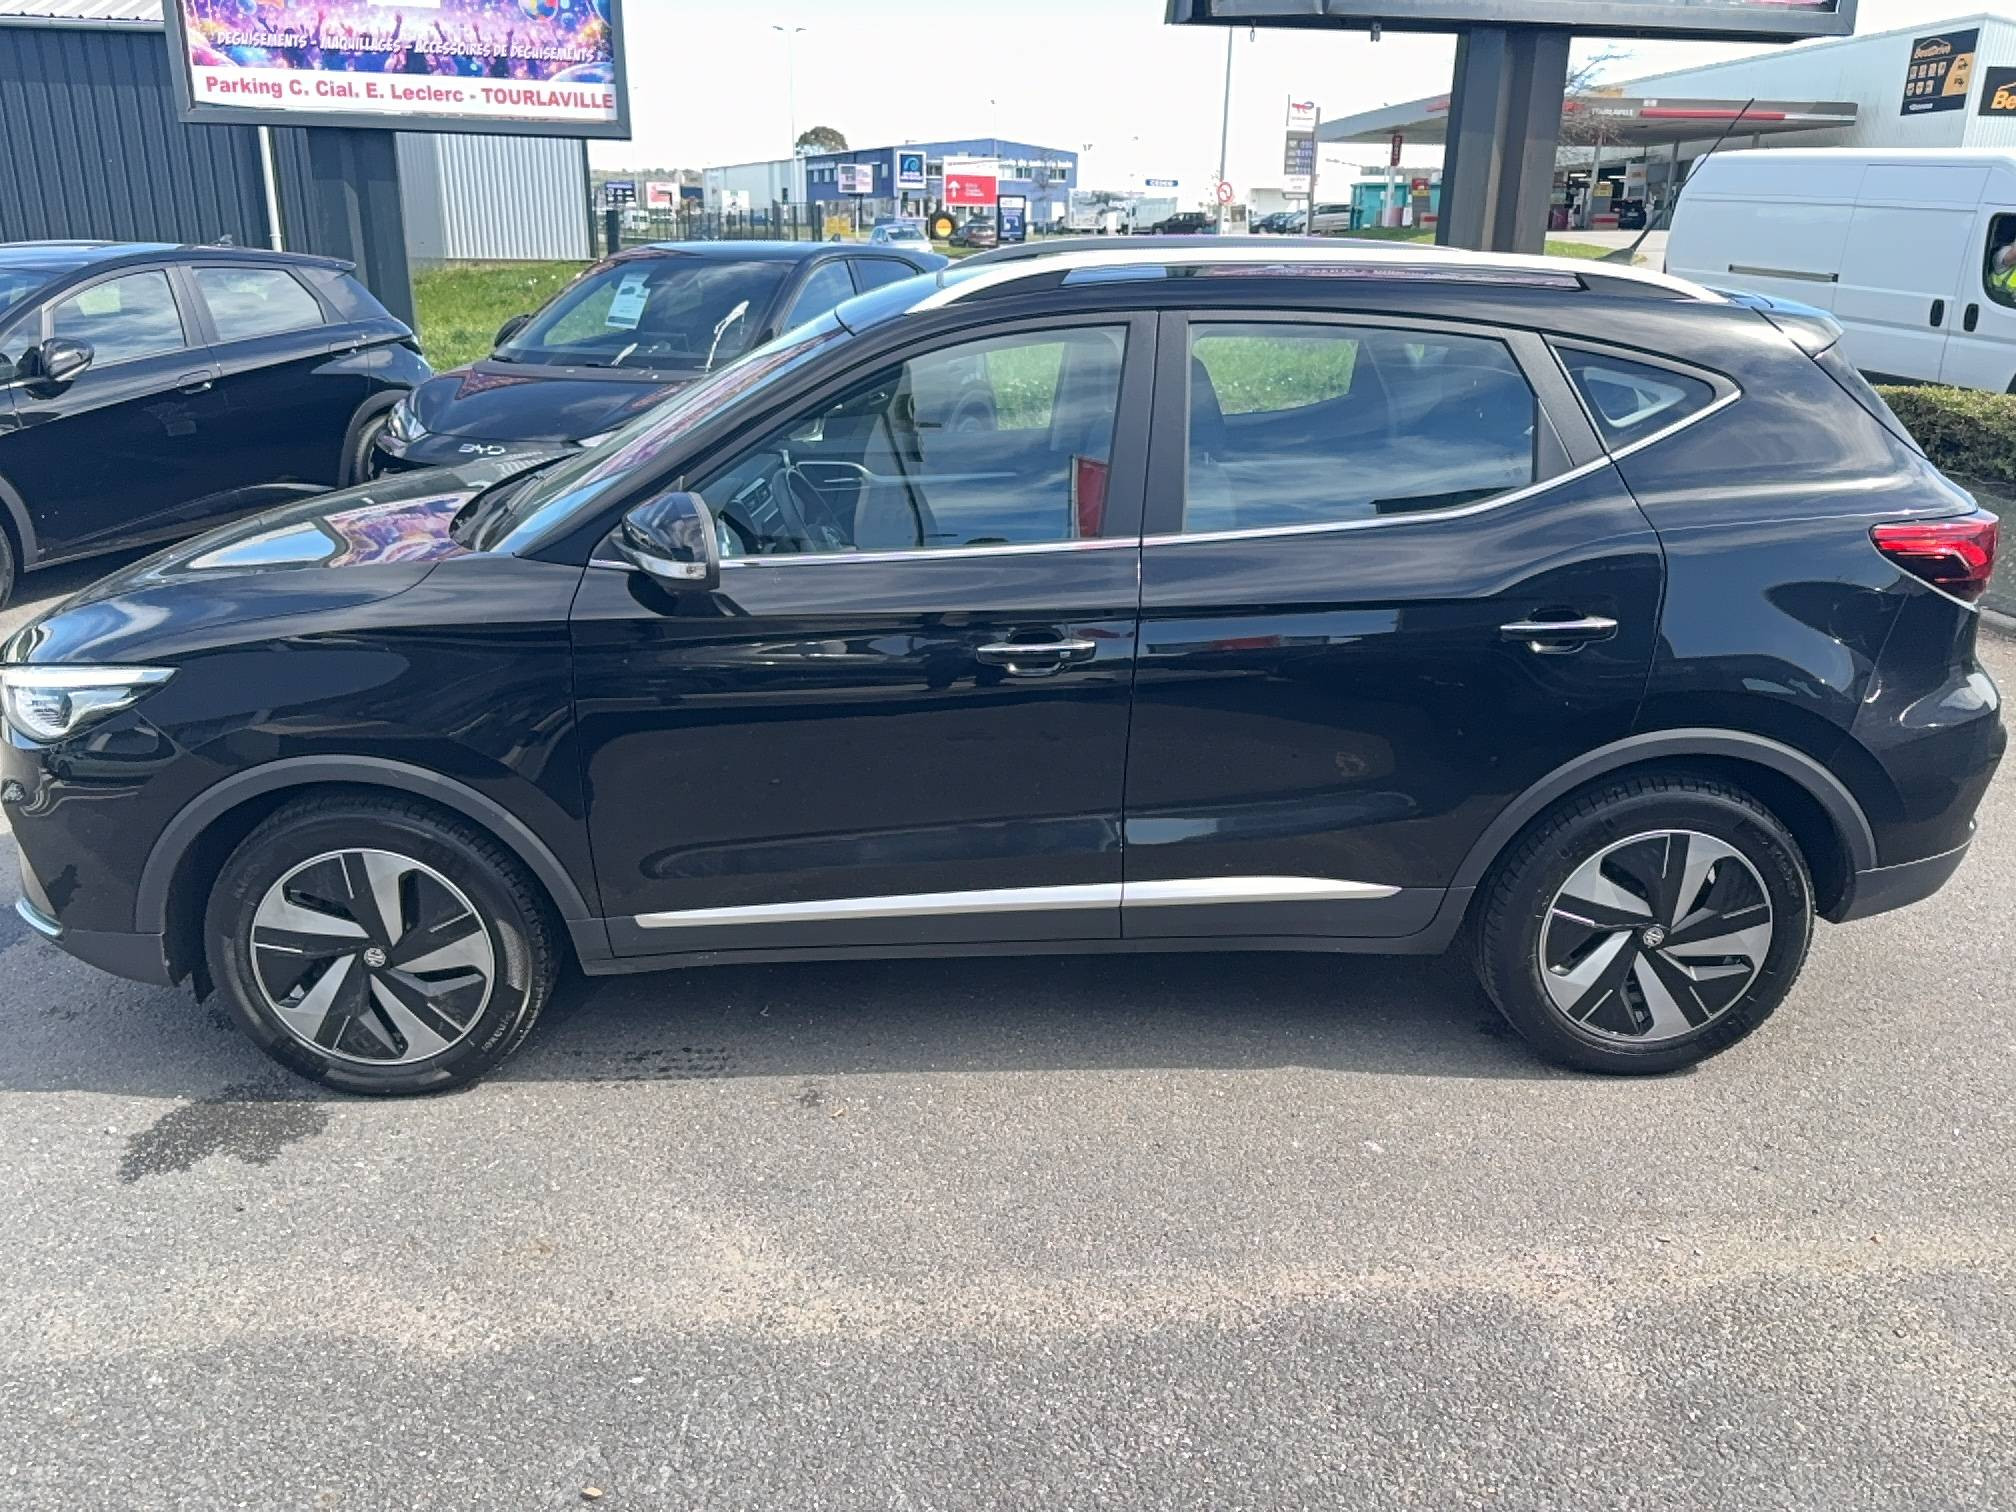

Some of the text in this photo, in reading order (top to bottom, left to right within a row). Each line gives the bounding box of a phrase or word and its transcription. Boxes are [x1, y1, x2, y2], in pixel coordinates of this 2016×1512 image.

[320, 34, 402, 53] MAQUILLAGES
[414, 39, 491, 57] ACCESSOIRES
[205, 76, 283, 98] Parking
[289, 79, 309, 96] C.
[316, 80, 359, 98] Cial.
[366, 82, 384, 99] E.
[391, 84, 464, 102] Leclerc
[481, 88, 613, 109] TOURLAVILLE
